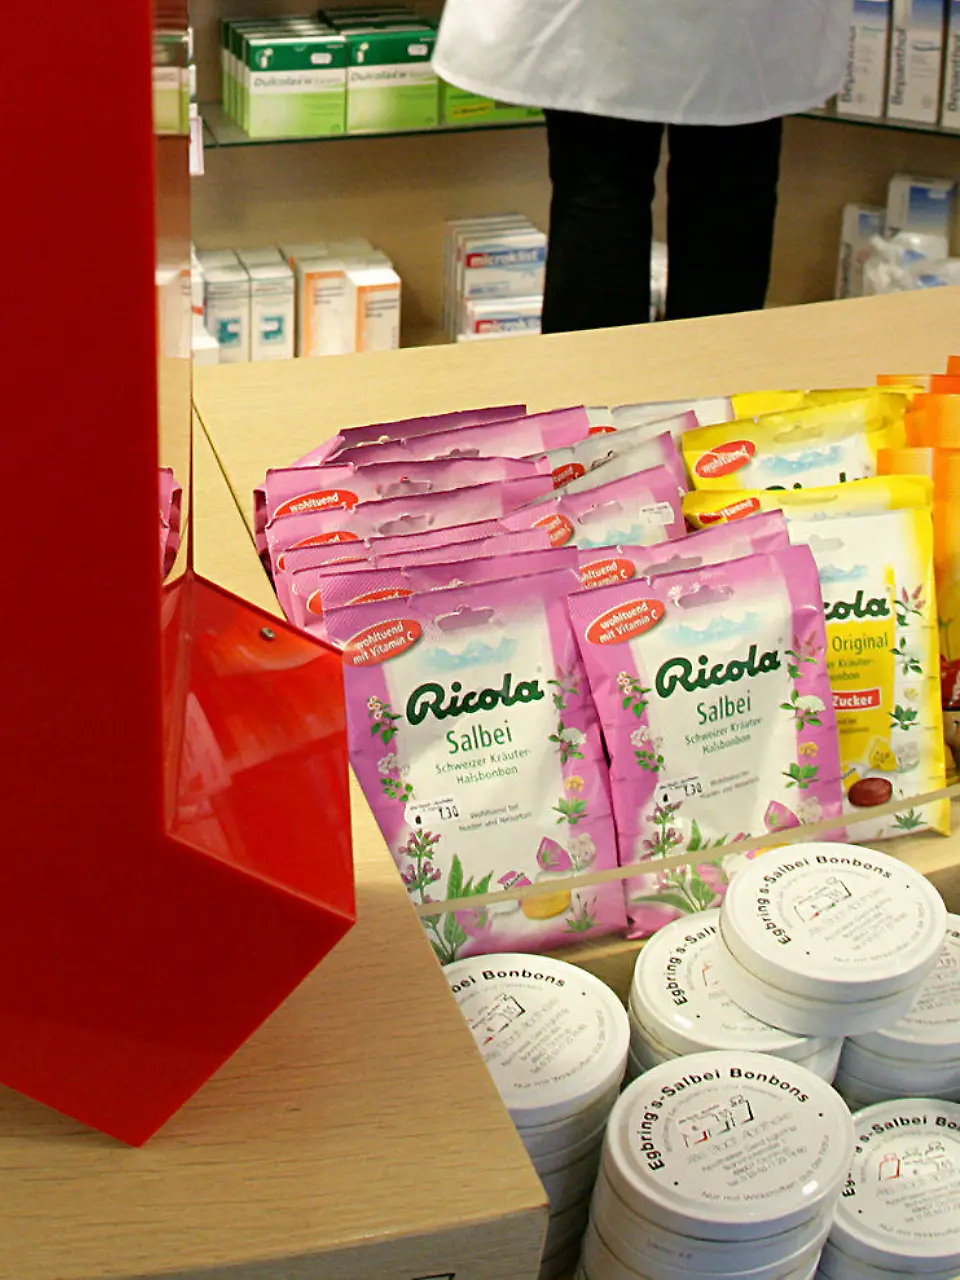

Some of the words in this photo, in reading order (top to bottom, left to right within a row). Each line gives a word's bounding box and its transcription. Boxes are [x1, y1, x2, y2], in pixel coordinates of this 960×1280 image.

[702, 445, 748, 474] wohltuend
[290, 492, 339, 514] wohltuend
[600, 602, 649, 629] wohltuend
[600, 630, 616, 644] mit
[616, 615, 650, 635] Vitamin
[651, 609, 659, 620] C
[353, 651, 369, 665] mit
[370, 637, 406, 657] Vitamin
[406, 630, 414, 642] C
[355, 620, 404, 648] wohltuend
[832, 632, 888, 656] Original
[655, 644, 781, 699] Ricola
[406, 672, 545, 726] Ricola
[697, 689, 752, 726] Salbei
[832, 693, 874, 708] Zucker
[446, 719, 513, 755] Salbei
[685, 725, 730, 746] Schweizer
[702, 733, 752, 756] Halsbonbon
[435, 757, 487, 775] Schweizer
[456, 765, 519, 784] Halsbonbon
[816, 855, 893, 880] Bonbons
[482, 968, 566, 988] Bonbons
[730, 1067, 809, 1104] Bonbons
